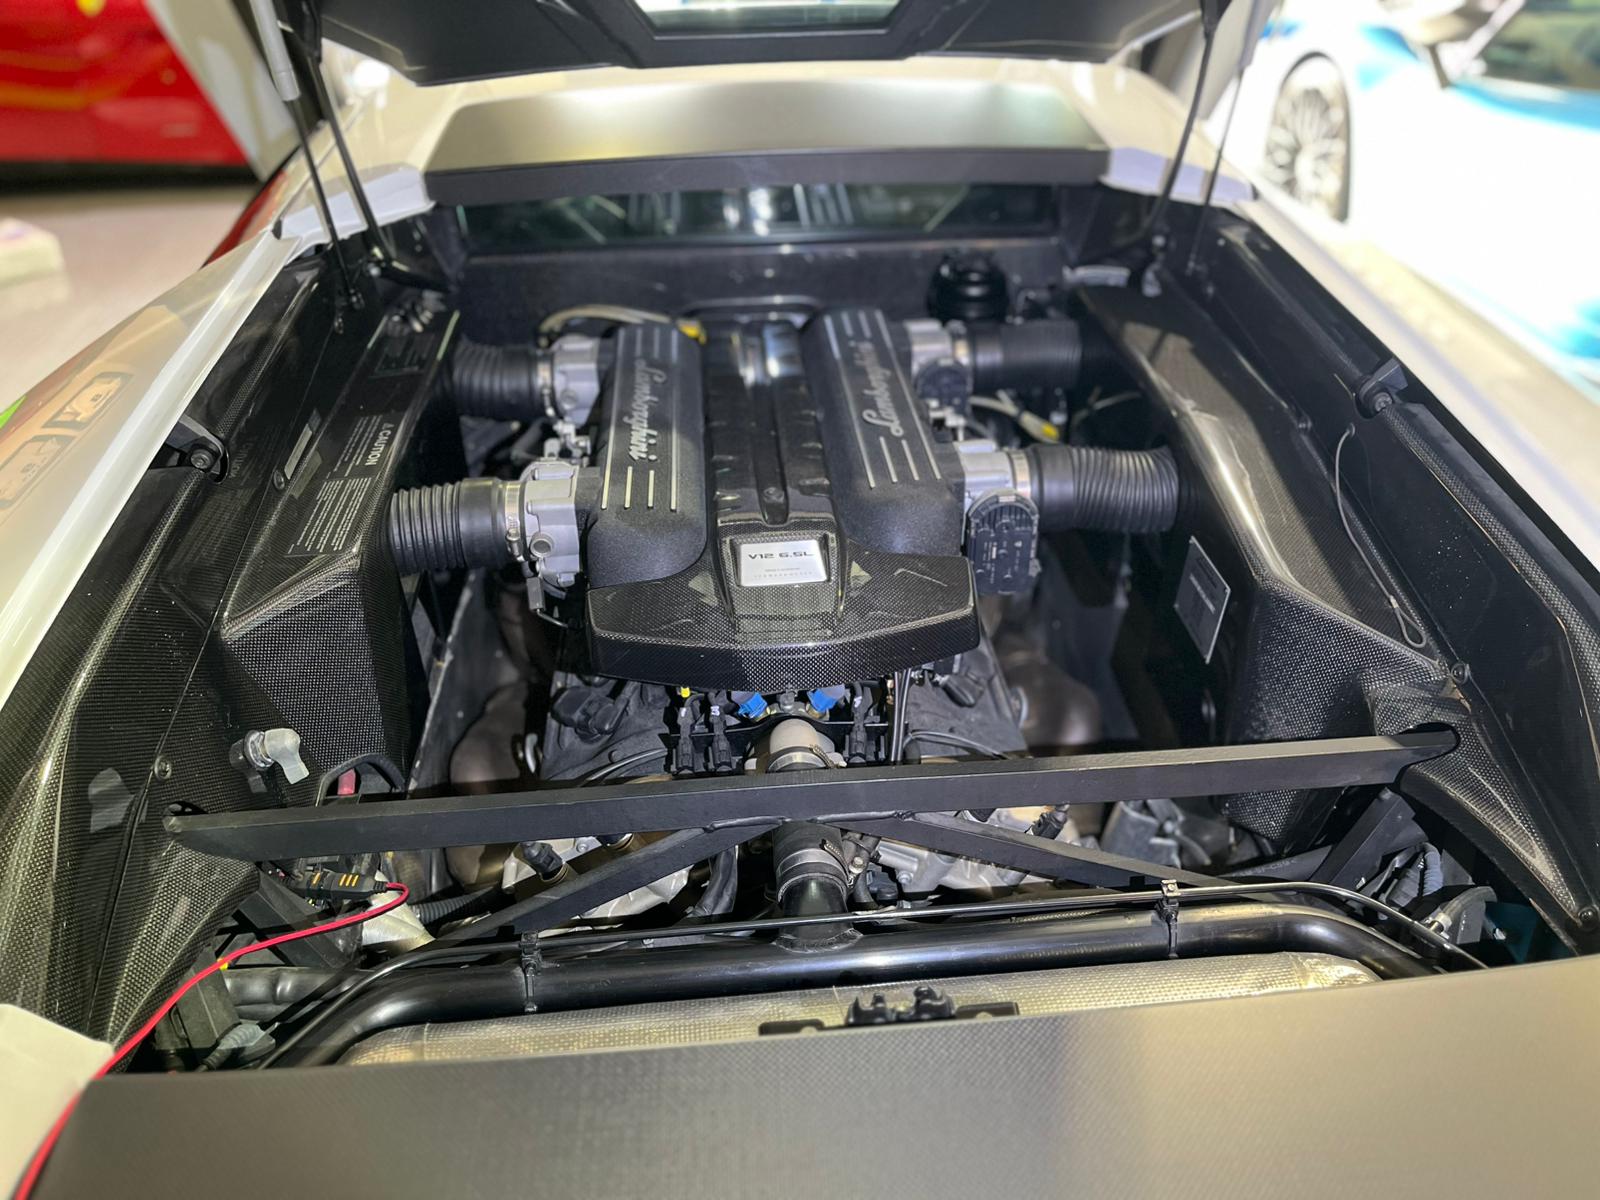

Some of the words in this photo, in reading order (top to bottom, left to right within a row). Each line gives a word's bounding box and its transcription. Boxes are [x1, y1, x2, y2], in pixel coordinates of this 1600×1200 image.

[622, 358, 667, 461] Lamborghini
[364, 430, 392, 466] CAUTION
[748, 552, 775, 560] V12
